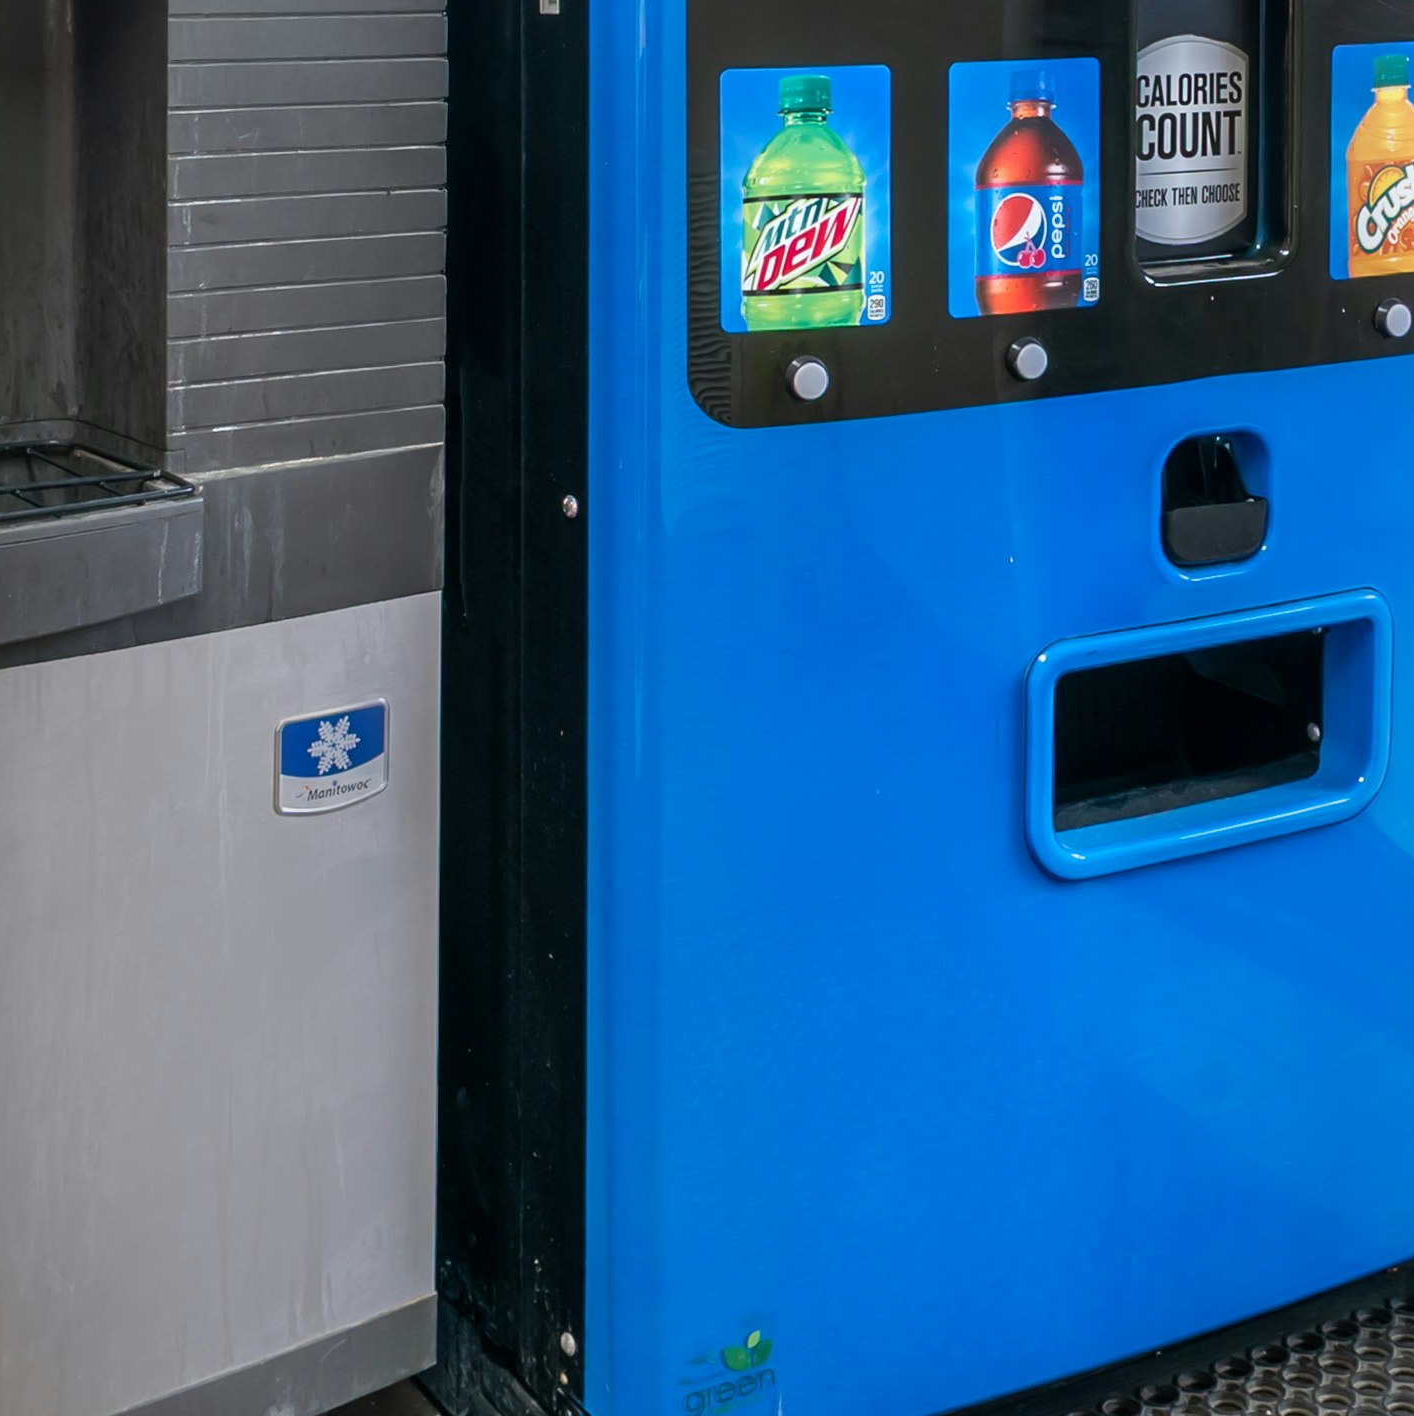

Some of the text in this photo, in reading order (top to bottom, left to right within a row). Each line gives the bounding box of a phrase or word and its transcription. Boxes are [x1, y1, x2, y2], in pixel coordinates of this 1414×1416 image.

[1136, 71, 1243, 108] CALORIES
[1136, 110, 1242, 161] COUNT
[1135, 182, 1241, 209] CHECK THEN CHOOSE
[755, 197, 824, 261] Mtn
[1049, 195, 1066, 259] pepsi
[1085, 254, 1098, 266] 20
[869, 271, 885, 284] 20
[870, 298, 884, 308] 290
[307, 777, 372, 801] Manitowoc
[683, 1368, 775, 1416] green
